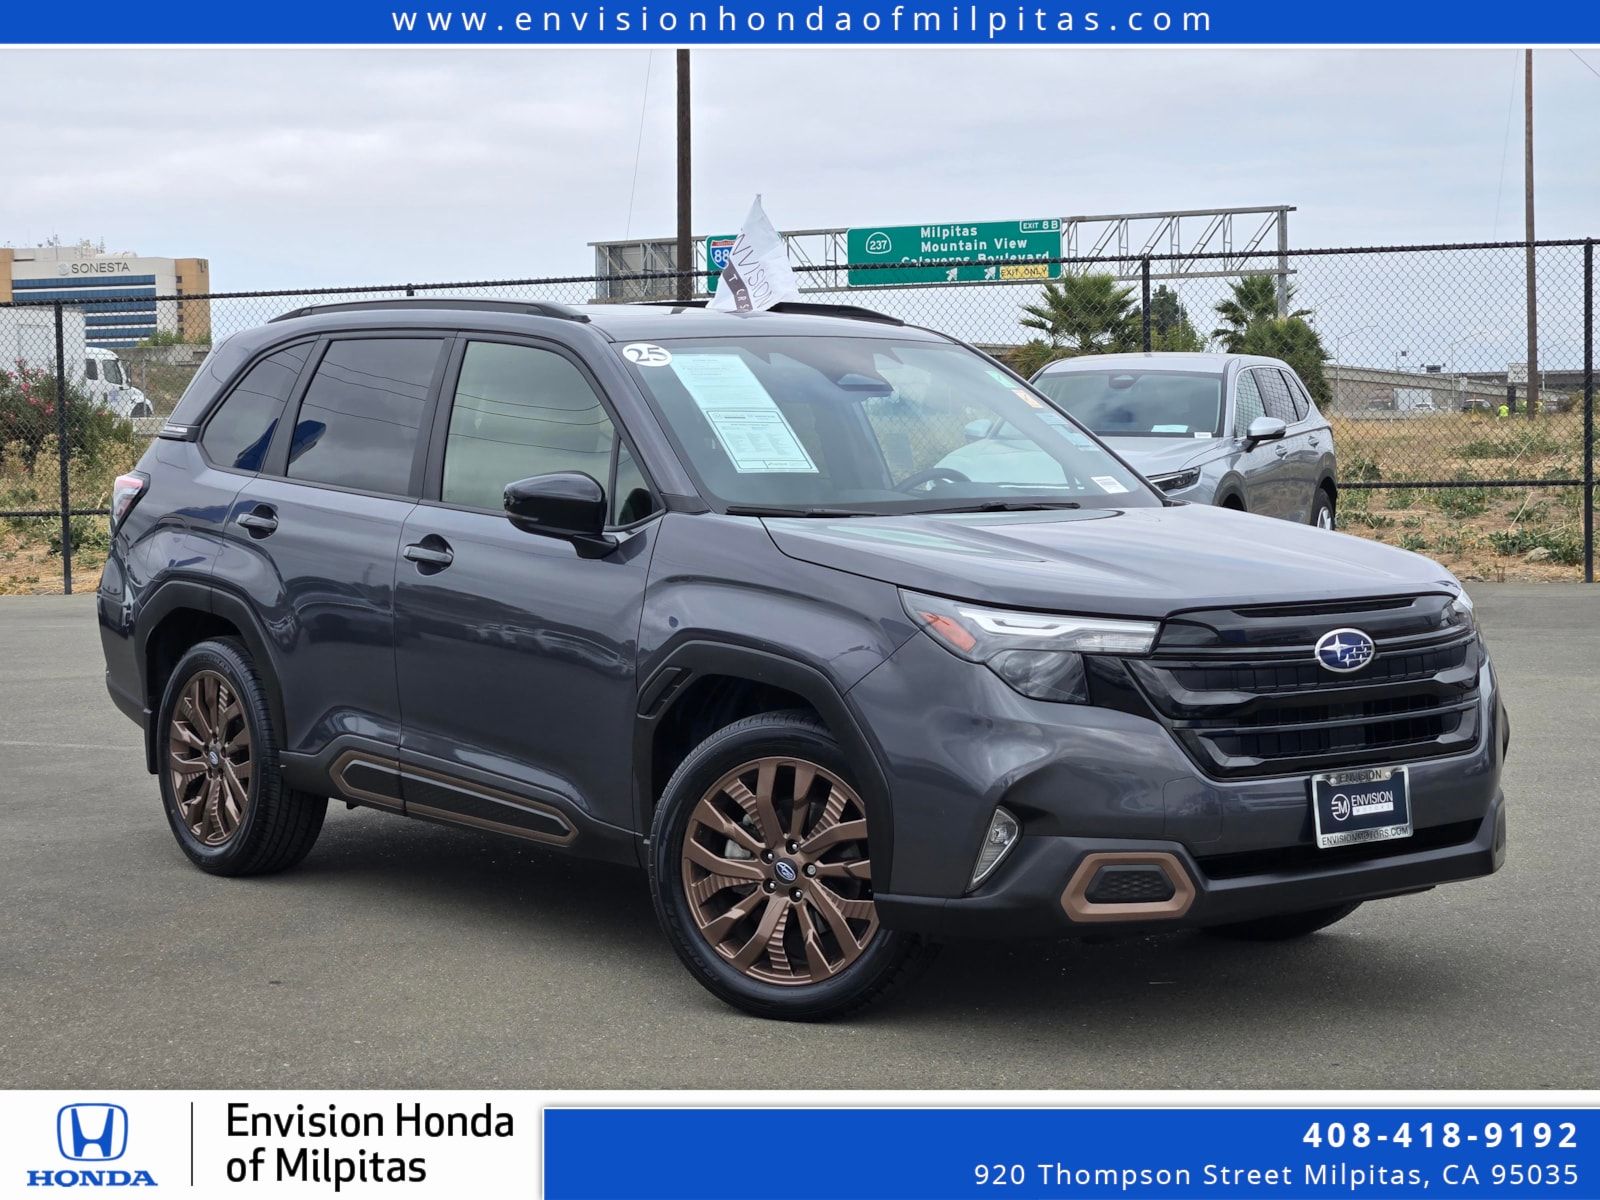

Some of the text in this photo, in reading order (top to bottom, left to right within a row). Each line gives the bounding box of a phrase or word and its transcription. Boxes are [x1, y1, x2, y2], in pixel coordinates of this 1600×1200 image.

[920, 225, 978, 240] Milpitas
[1022, 222, 1040, 230] EXIT
[869, 240, 888, 251] 237
[921, 238, 1028, 253] Mountain View
[71, 262, 130, 274] SONESTA
[1001, 266, 1047, 277] EXIT ONLY
[626, 347, 669, 362] 25
[1351, 790, 1393, 806] ENVISION
[1322, 827, 1408, 846] ENVISIONMOTORS.COM
